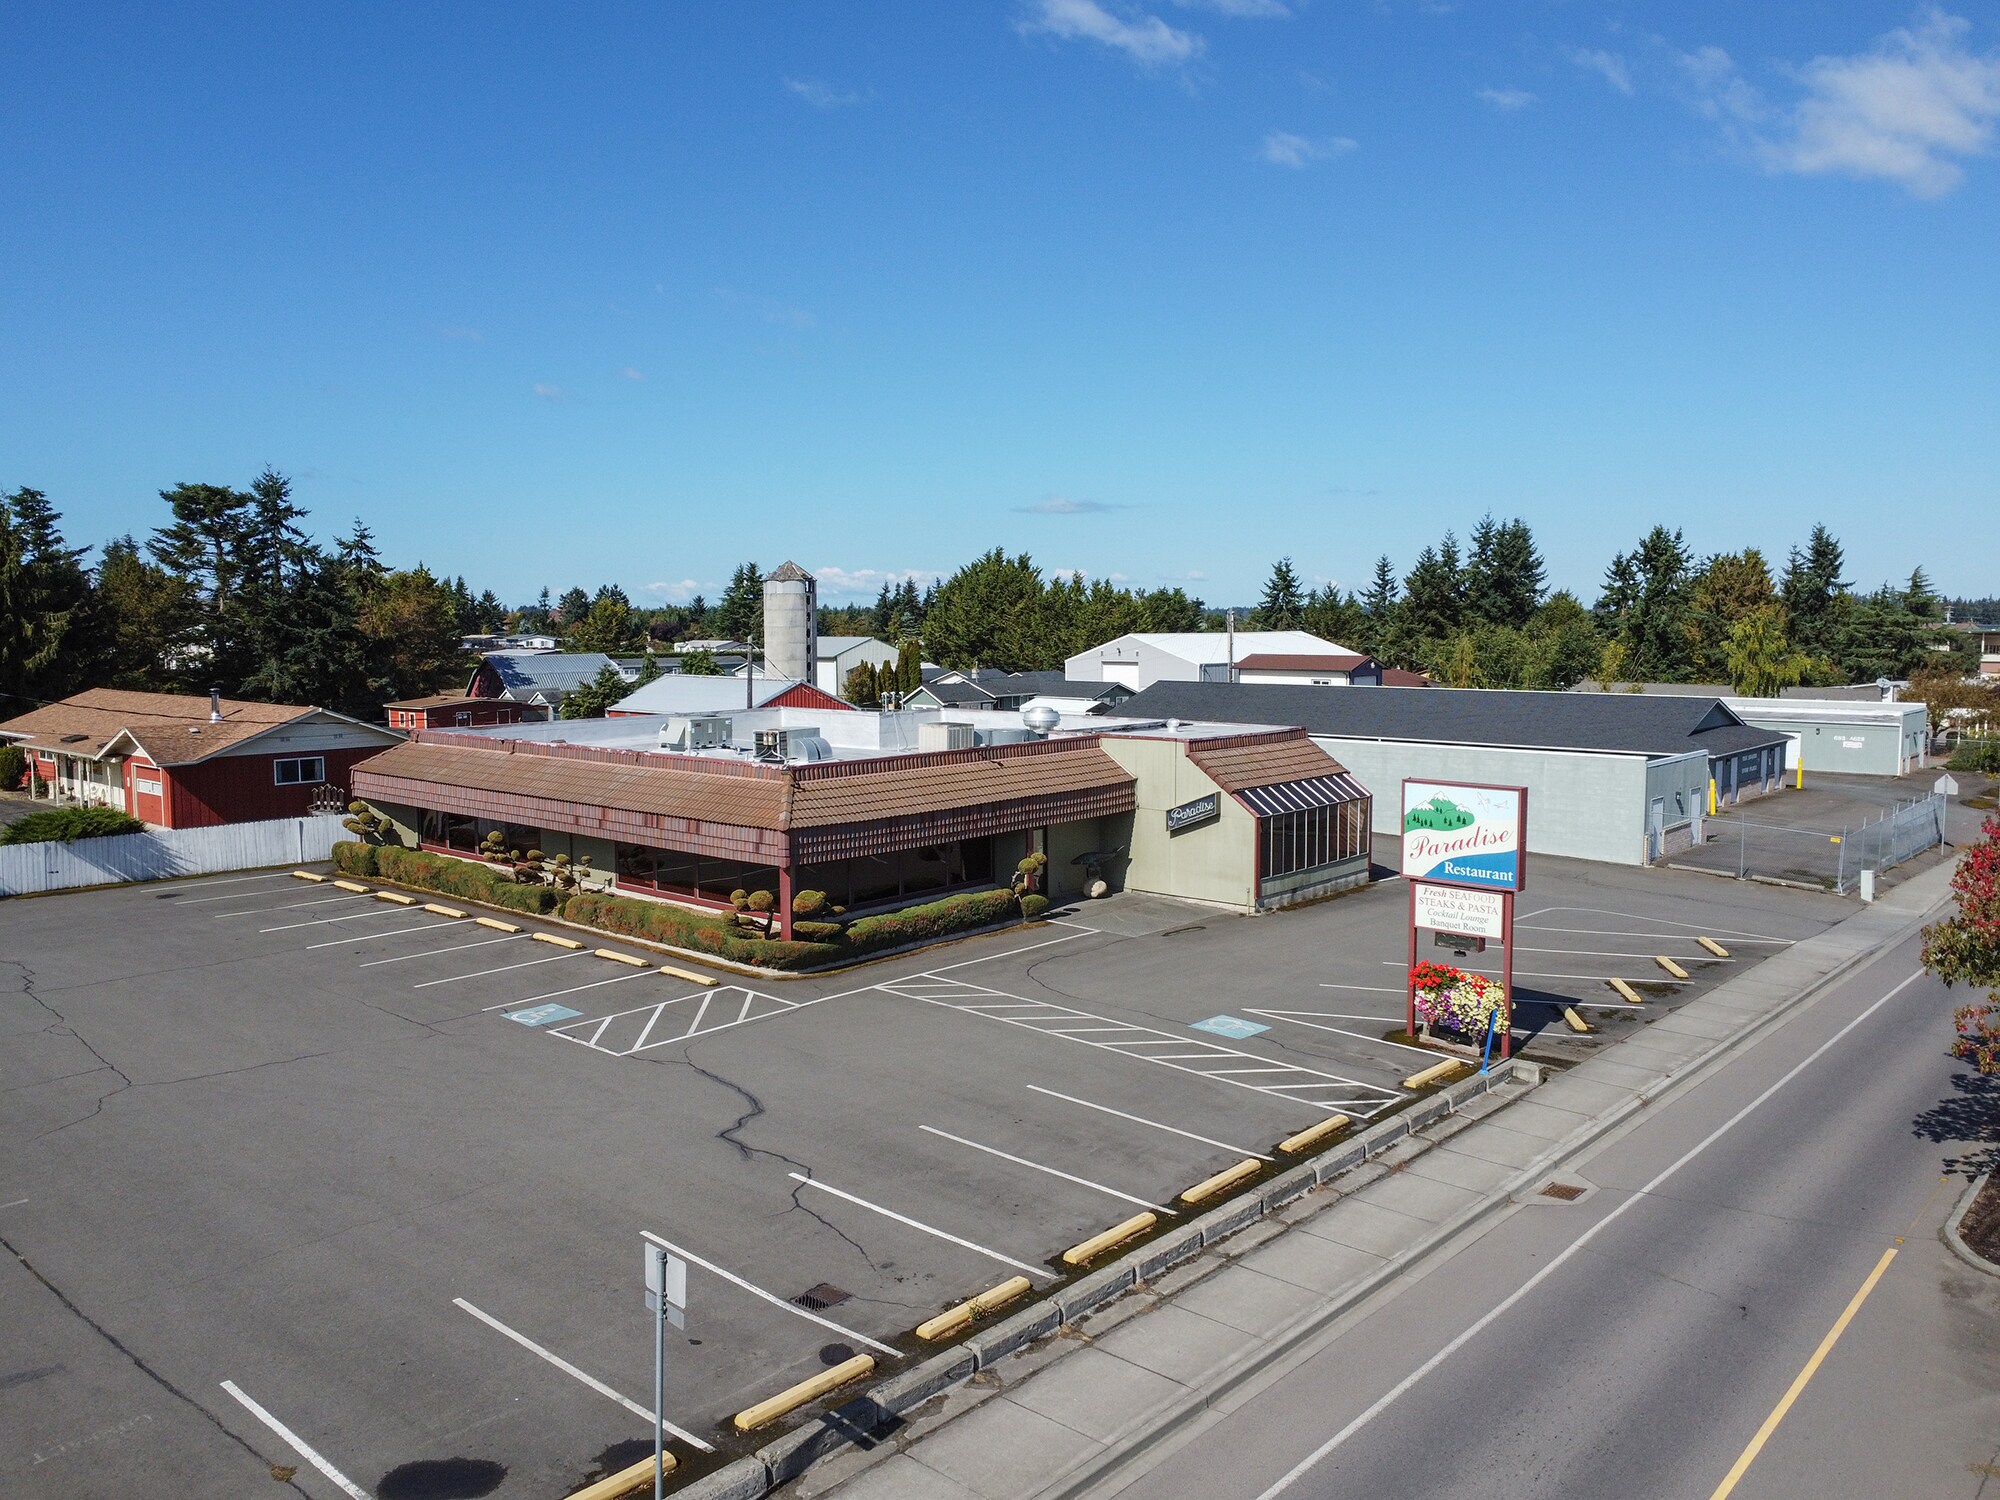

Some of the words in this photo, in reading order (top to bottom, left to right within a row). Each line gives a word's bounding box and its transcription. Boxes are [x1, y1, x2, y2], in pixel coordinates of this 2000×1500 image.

[1168, 801, 1214, 827] Paradise
[1409, 826, 1513, 859] Paradise
[1444, 861, 1514, 882] Restaurant
[1423, 887, 1447, 898] Fresh
[1449, 890, 1496, 904] SEAFOOD
[1418, 896, 1456, 909] STEAKS
[1457, 902, 1466, 911] &
[1468, 903, 1498, 915] PASTA
[1427, 907, 1459, 920] Cocktail
[1460, 912, 1489, 924] Lounge
[1430, 917, 1461, 929] Banquet
[1463, 922, 1486, 933] Room
